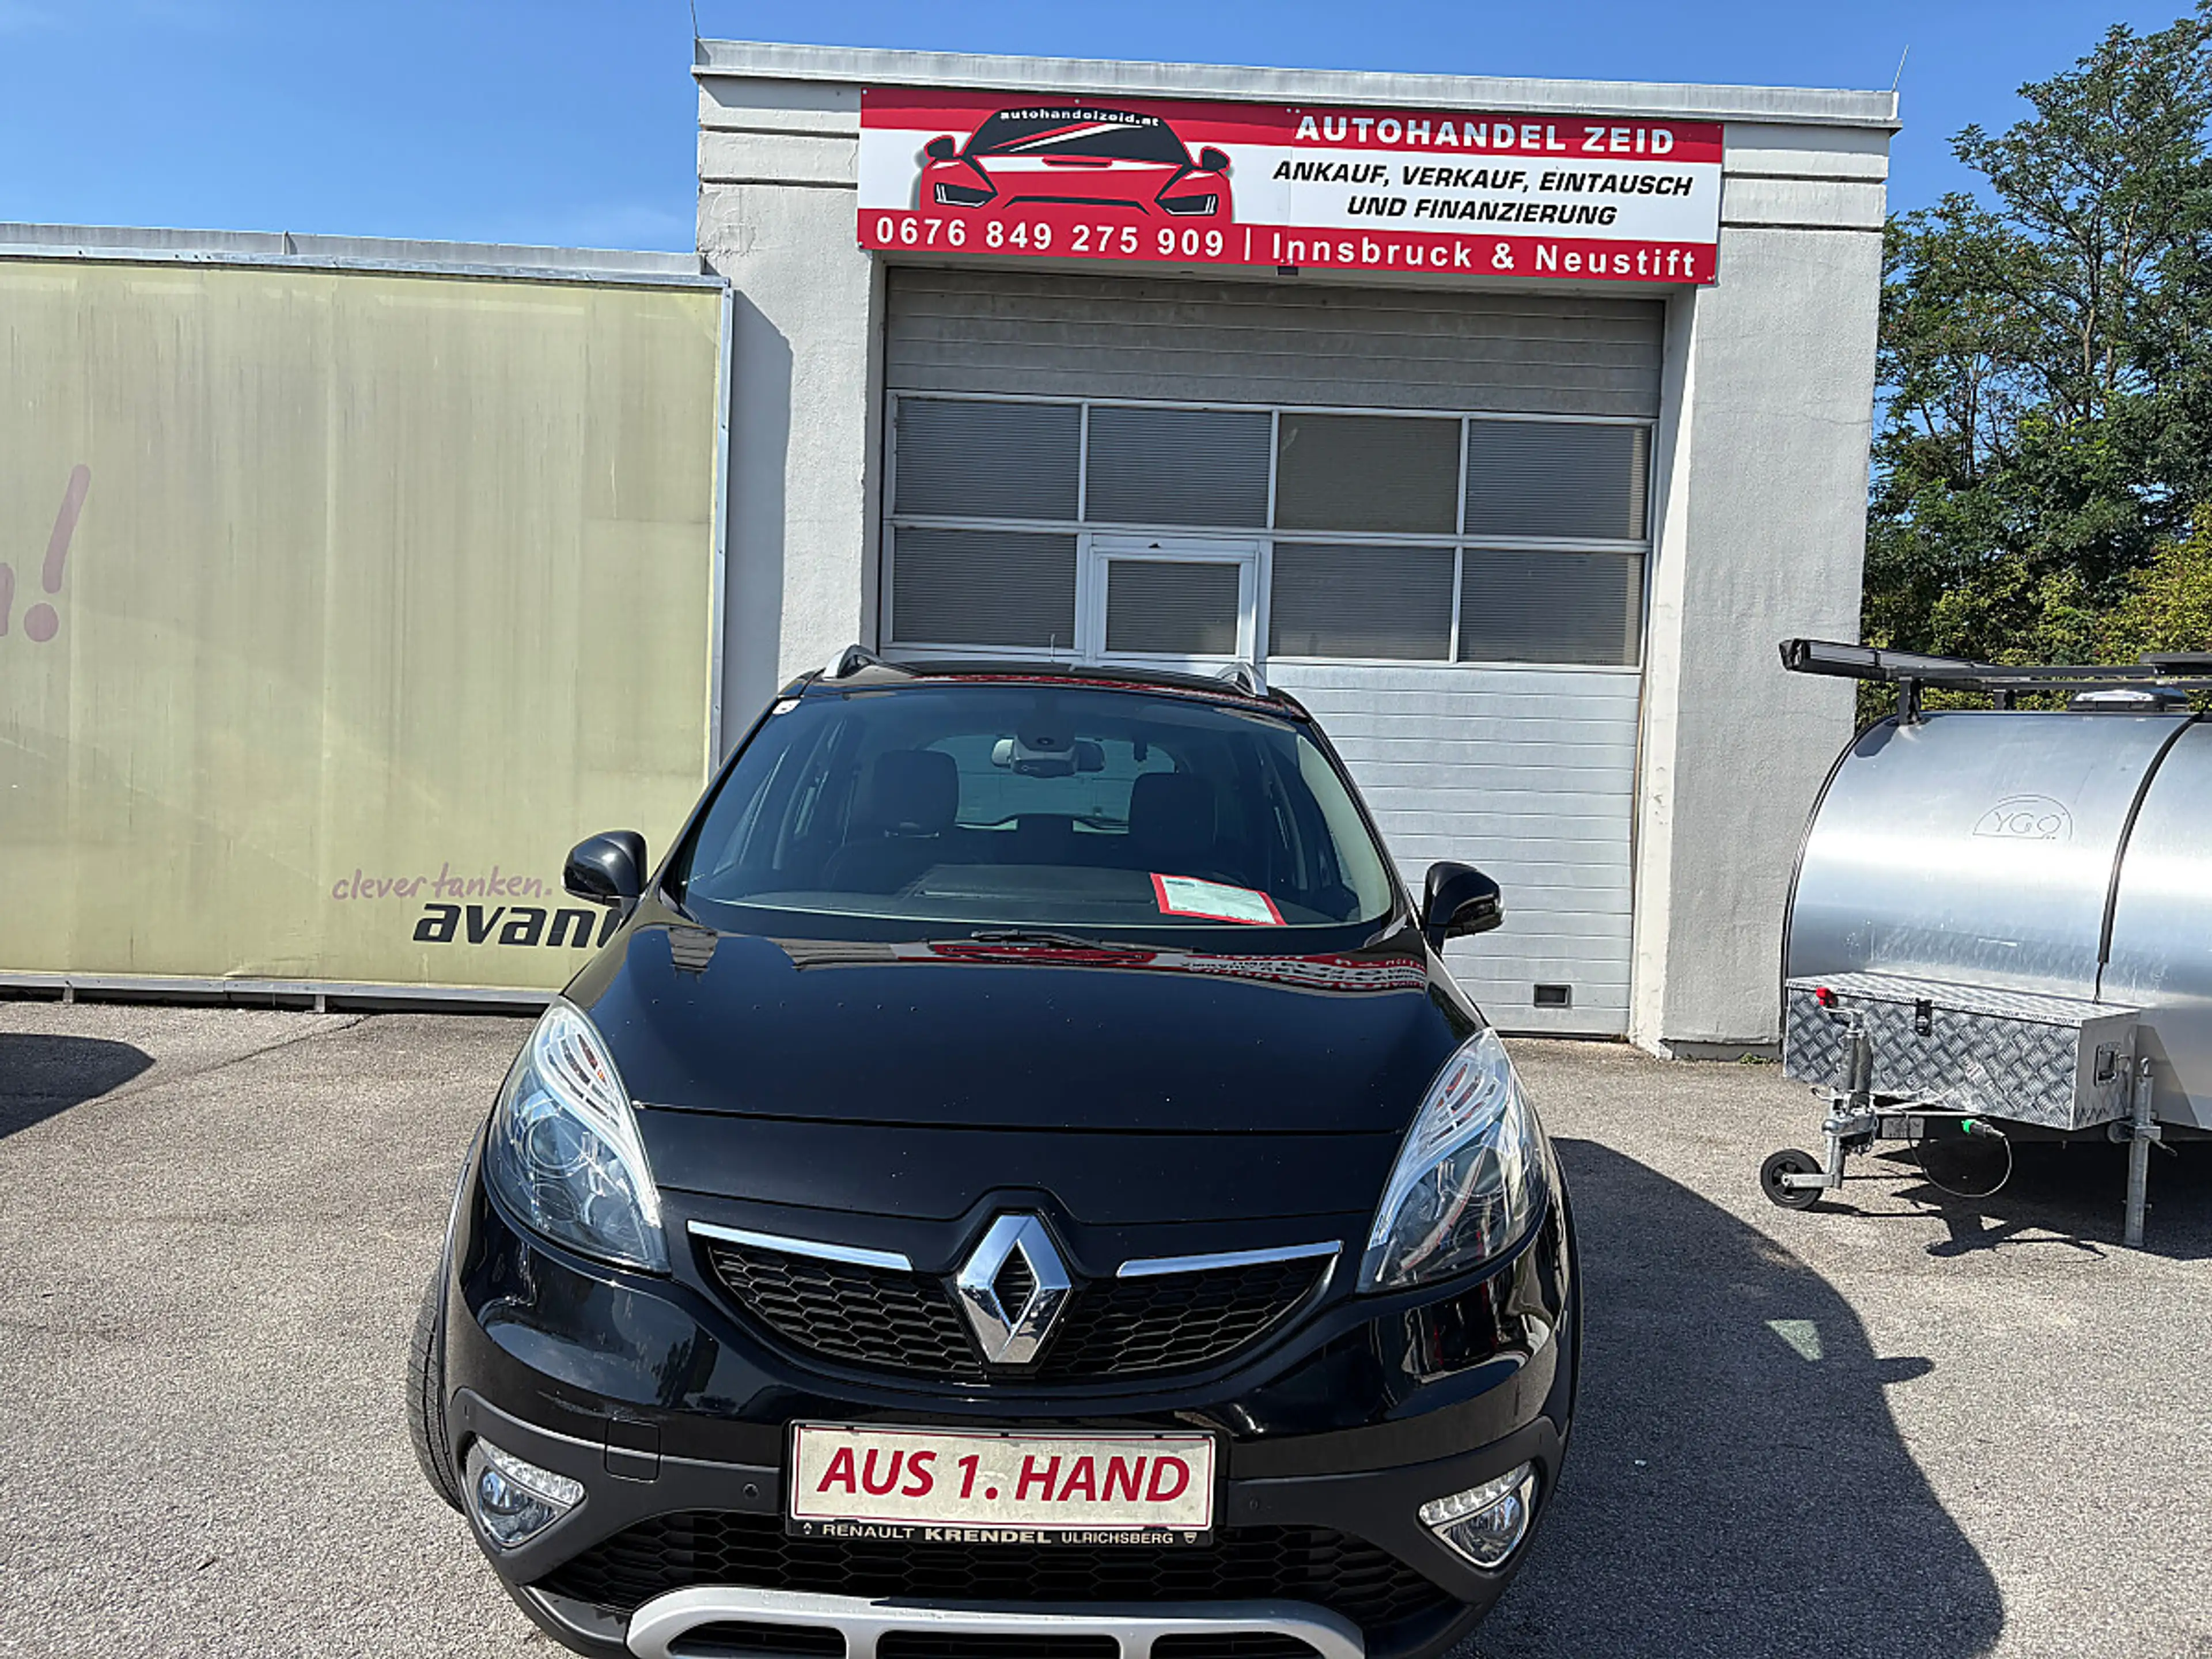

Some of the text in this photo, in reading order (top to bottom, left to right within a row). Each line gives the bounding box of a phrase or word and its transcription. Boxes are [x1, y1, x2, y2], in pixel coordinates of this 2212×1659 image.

[1294, 116, 1674, 154] AUTOHANDEL ZEID
[1273, 161, 1693, 197] ANKAUF, VERKAUF, EINTAUSCH
[1347, 196, 1618, 226] UND FINANZIERUNG
[877, 217, 965, 245] 0676
[986, 221, 1052, 249] 849
[1071, 225, 1138, 253] 275
[1157, 228, 1224, 257] 909
[1273, 232, 1473, 268] Innsbruck
[1491, 243, 1515, 270] &
[1536, 244, 1696, 278] Neustift
[332, 862, 553, 900] clever tanken.
[816, 1447, 1190, 1502] AUS 1. HAND
[823, 1524, 1173, 1544] RENAULT KRENDEL ULRICHSBERG
